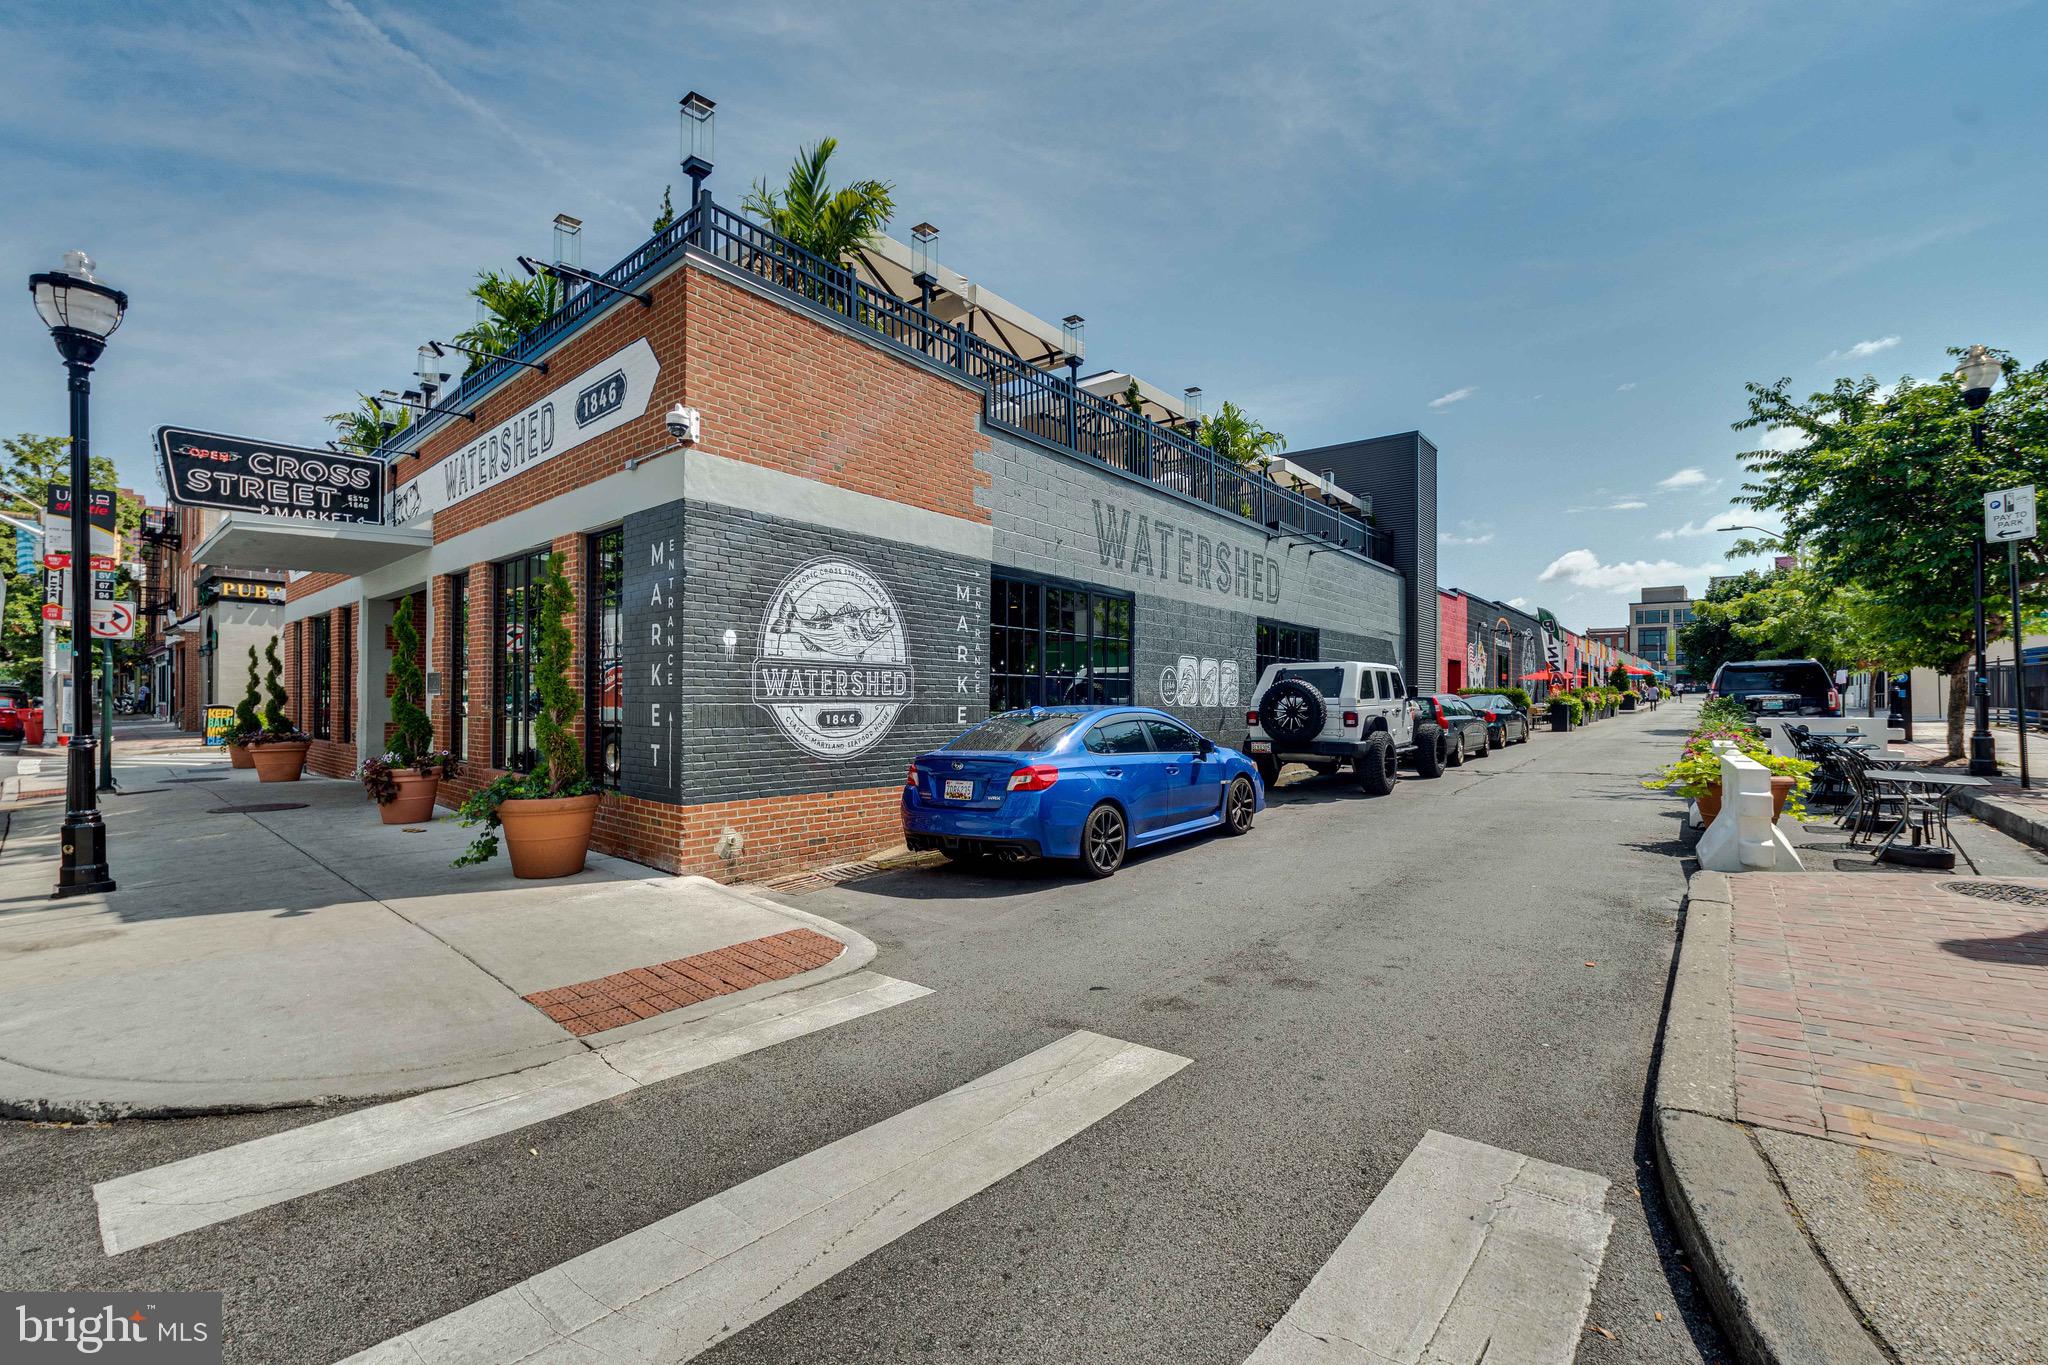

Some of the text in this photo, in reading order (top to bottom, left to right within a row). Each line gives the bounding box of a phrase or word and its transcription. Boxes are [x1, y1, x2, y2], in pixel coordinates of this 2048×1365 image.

[444, 382, 617, 501] WATERSHED 1846
[189, 447, 231, 462] OPEN
[249, 452, 371, 489] CROSS
[186, 468, 337, 508] STREET
[347, 494, 370, 503] ESTD
[1993, 510, 2028, 522] PAY TO
[1997, 518, 2025, 528] PARK
[1091, 499, 1280, 605] WATERSHED
[50, 575, 58, 599] LINK
[222, 582, 268, 599] PUB
[667, 539, 676, 685] ENTRANCE
[651, 541, 664, 767] MARKET
[956, 584, 970, 725] MARKE
[761, 668, 907, 696] WATERSHED
[207, 708, 234, 718] KEEP
[207, 717, 233, 728] BALTI
[826, 714, 855, 726] 1846
